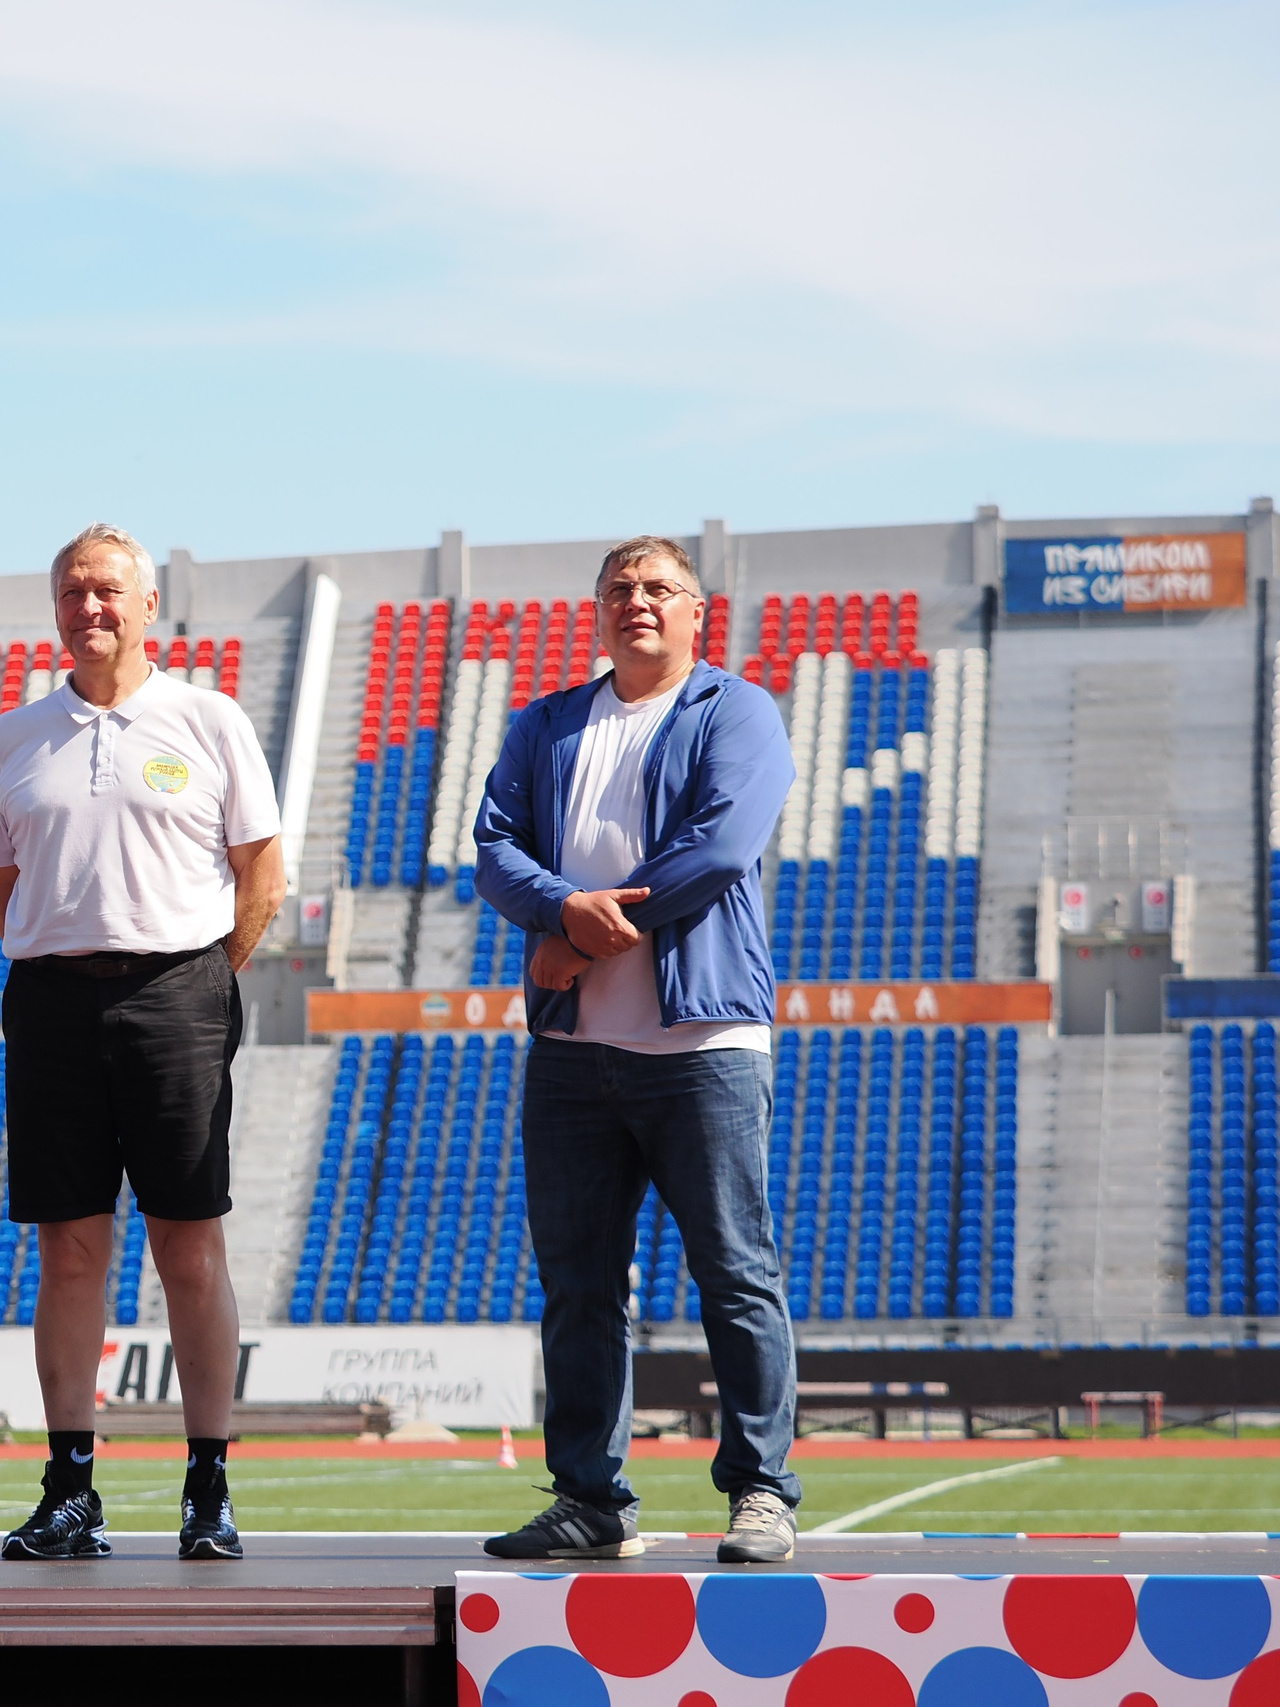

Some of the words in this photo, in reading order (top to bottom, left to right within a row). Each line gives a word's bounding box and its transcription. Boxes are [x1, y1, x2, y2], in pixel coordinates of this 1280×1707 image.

[1044, 541, 1211, 574] ПРЯМИКОМ
[1043, 575, 1088, 606] ИЗ
[1090, 572, 1212, 605] СИБИРИ
[785, 986, 939, 1022] АНДА
[327, 1349, 438, 1372] ГРУППА
[322, 1377, 483, 1404] КОМПАНИЙ
